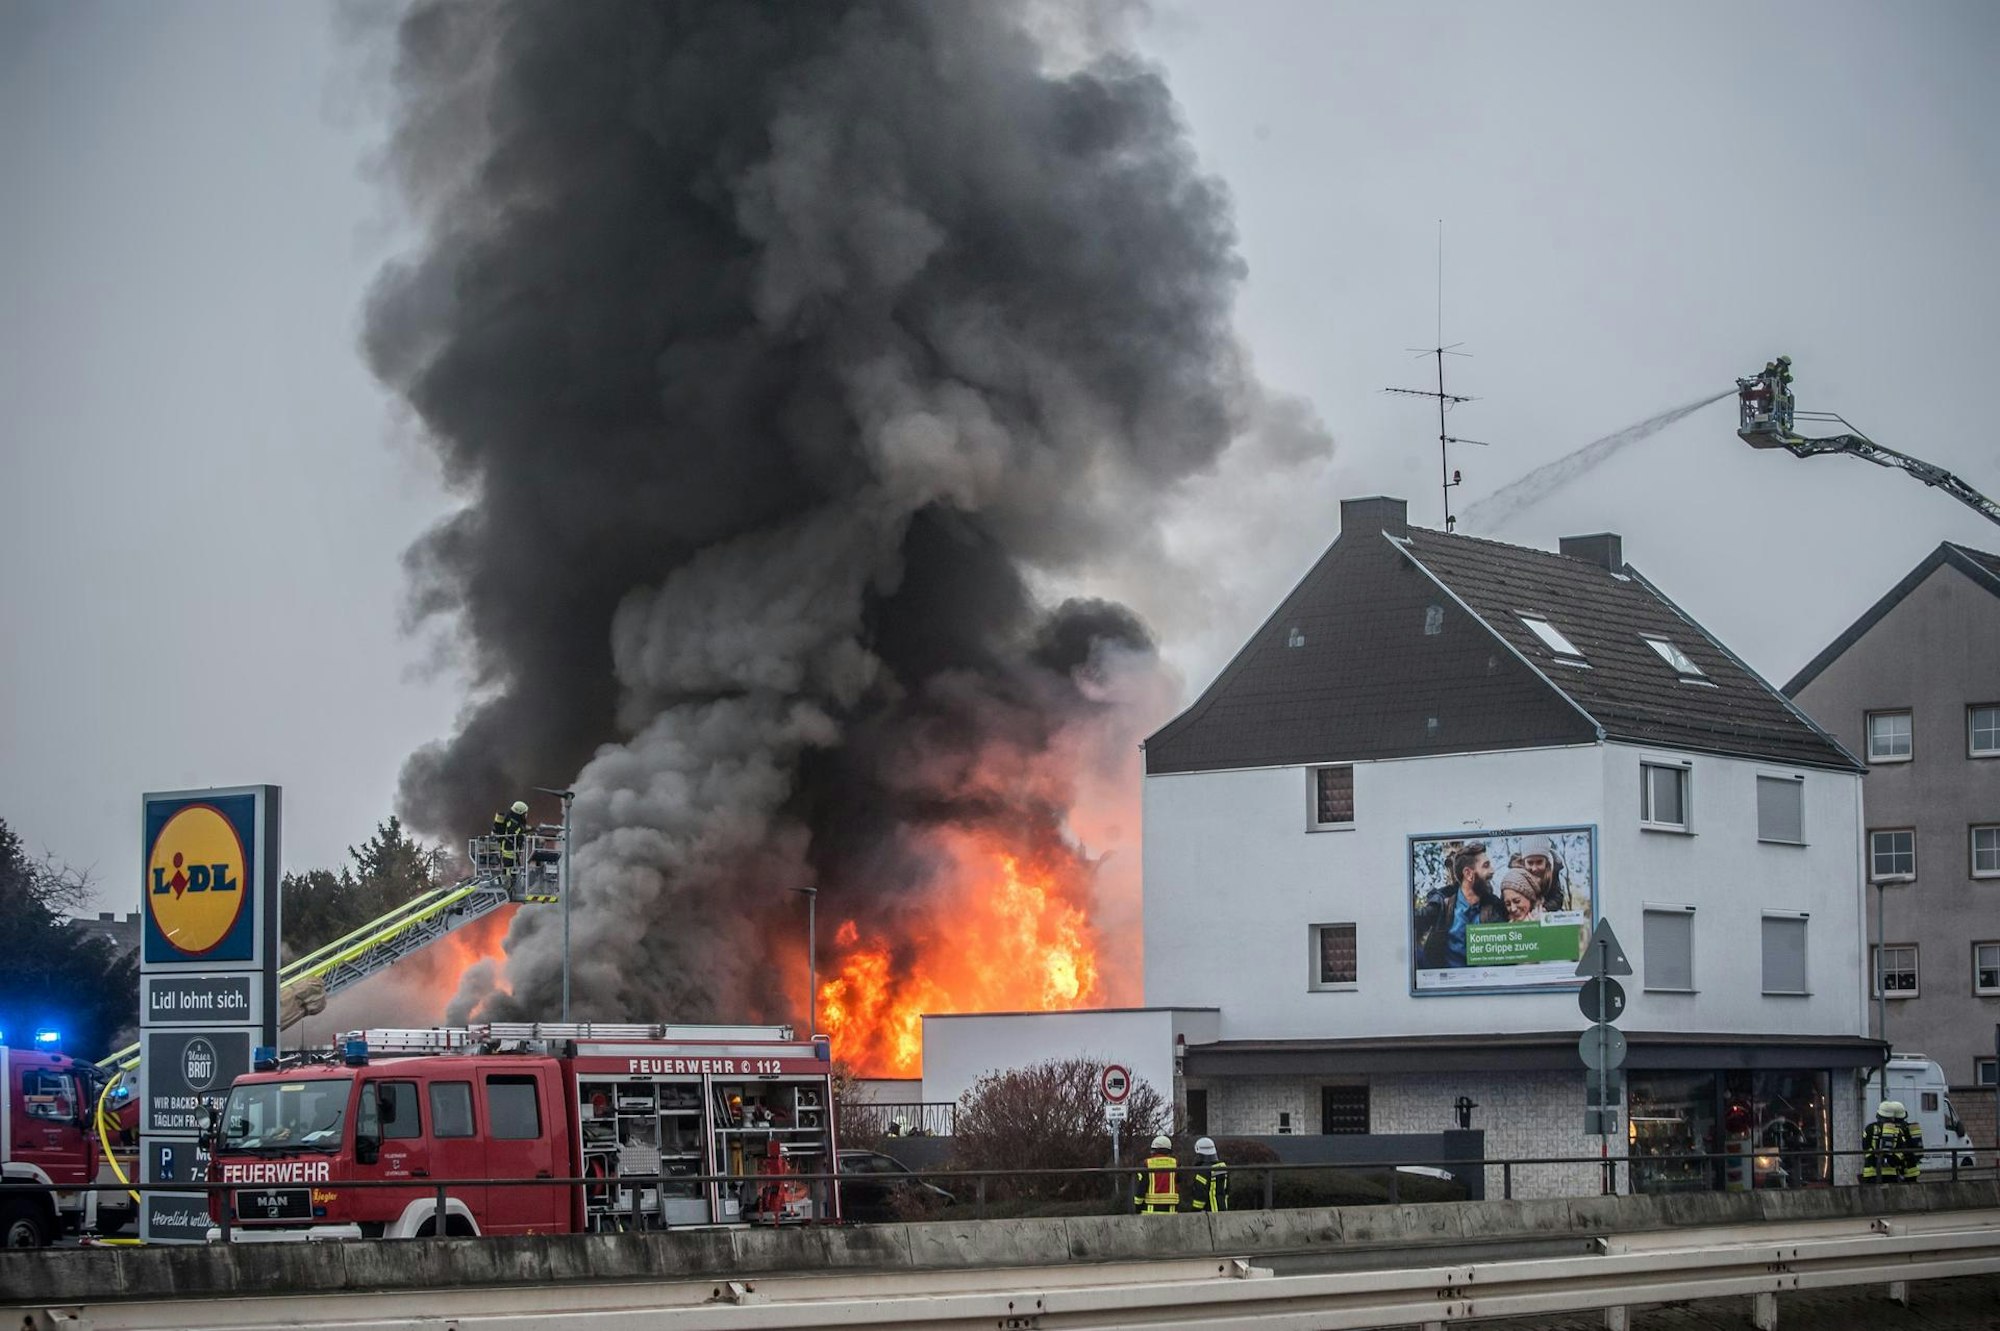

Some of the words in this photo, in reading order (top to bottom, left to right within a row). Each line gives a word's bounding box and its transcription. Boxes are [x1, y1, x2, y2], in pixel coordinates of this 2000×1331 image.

[1470, 932, 1507, 943] Kommen
[1508, 931, 1523, 941] Sie
[1470, 944, 1483, 954] der
[1485, 943, 1513, 954] Grippe
[1514, 941, 1540, 951] zuvor.
[152, 991, 176, 1009] Lidl
[180, 991, 213, 1009] lohnt
[217, 990, 248, 1008] sich.
[188, 1061, 211, 1078] BROT
[629, 1060, 734, 1073] FEUERWEHR
[757, 1060, 781, 1073] 112
[154, 1096, 170, 1110] WIR
[154, 1112, 184, 1127] TÄGLICH
[161, 1148, 172, 1166] P
[224, 1161, 330, 1183] FEUERWEHR
[257, 1196, 289, 1207] MAN
